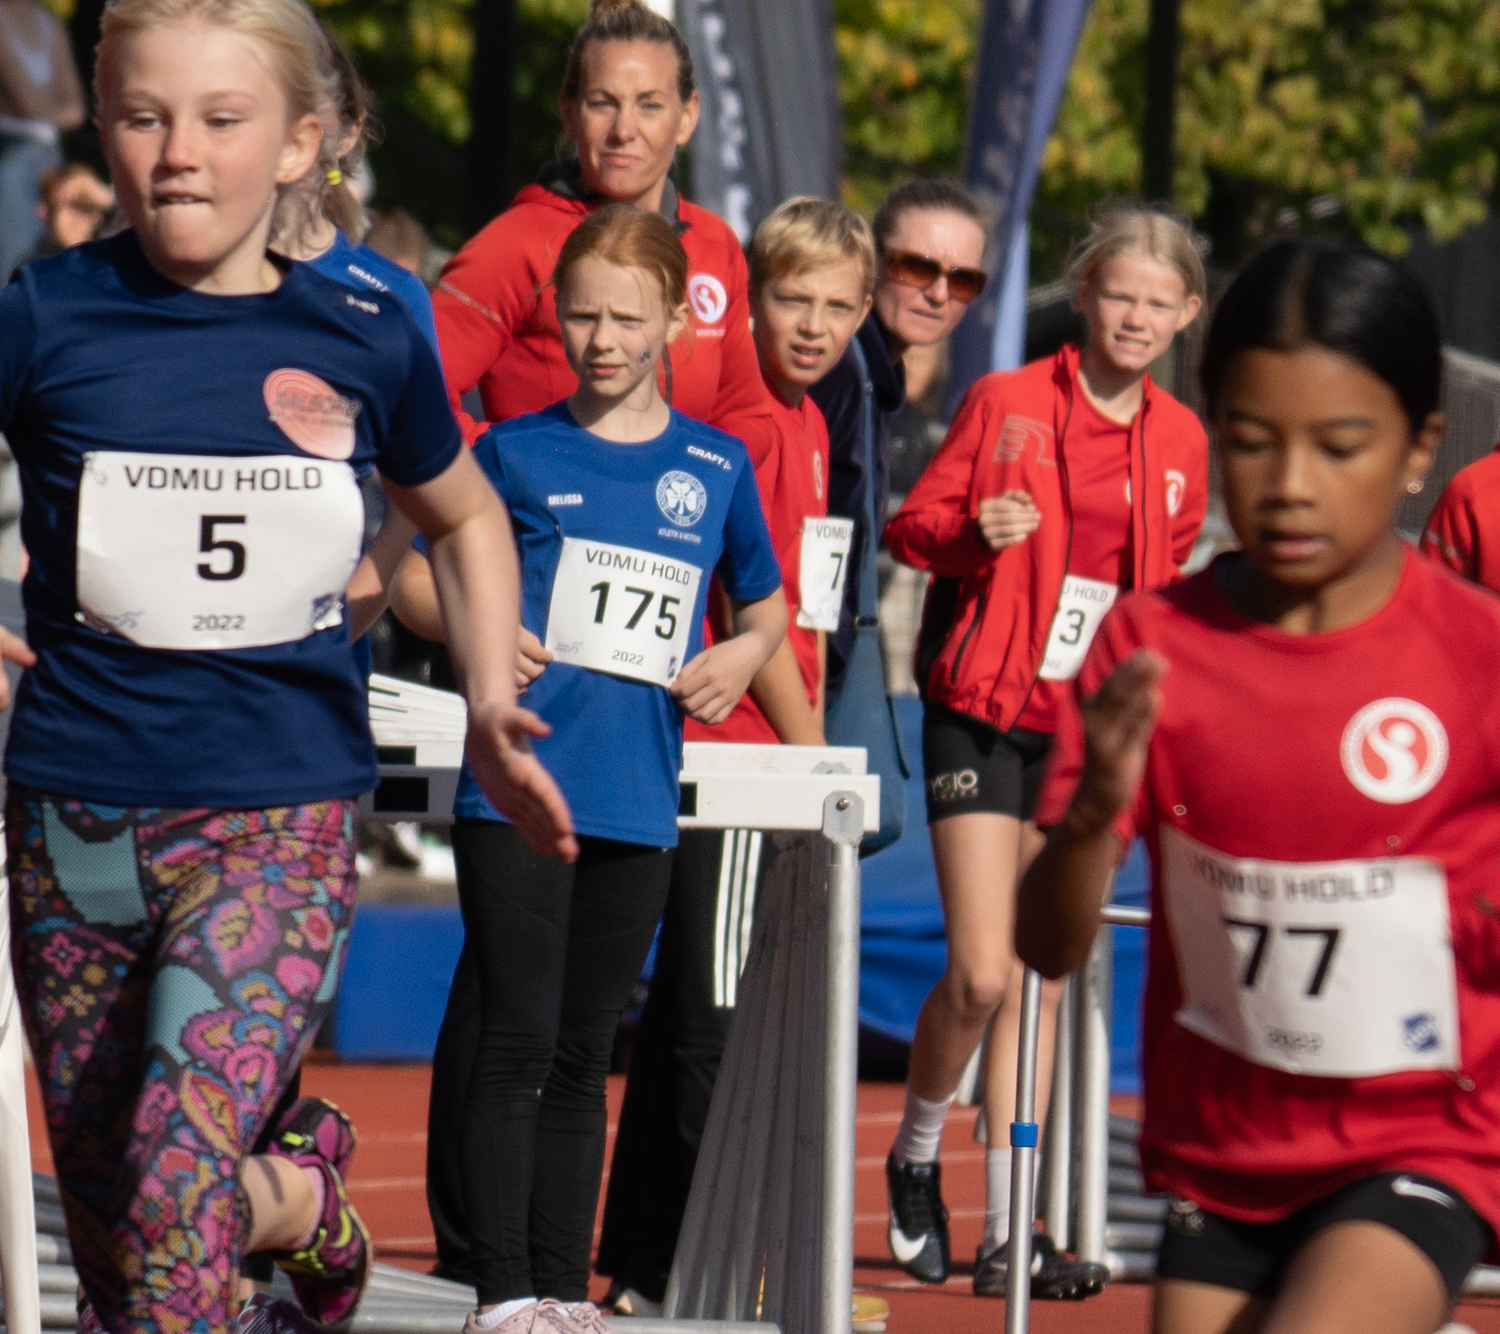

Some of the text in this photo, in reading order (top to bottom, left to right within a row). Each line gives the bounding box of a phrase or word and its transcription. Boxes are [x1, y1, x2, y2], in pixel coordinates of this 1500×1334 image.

[348, 264, 383, 292] CRAFT
[687, 445, 725, 466] CRAFT
[124, 465, 323, 491] VDMU HOLD
[548, 493, 584, 506] MELISSA
[816, 525, 847, 540] VDMU
[196, 514, 248, 581] 5
[586, 548, 691, 586] VDMU HOLD
[830, 552, 844, 591] 7
[1074, 585, 1109, 603] HOLD
[192, 614, 246, 632] 2022
[590, 580, 681, 641] 175
[612, 649, 644, 666] 2022
[1283, 866, 1395, 902] HOLD
[1222, 917, 1341, 998] 77
